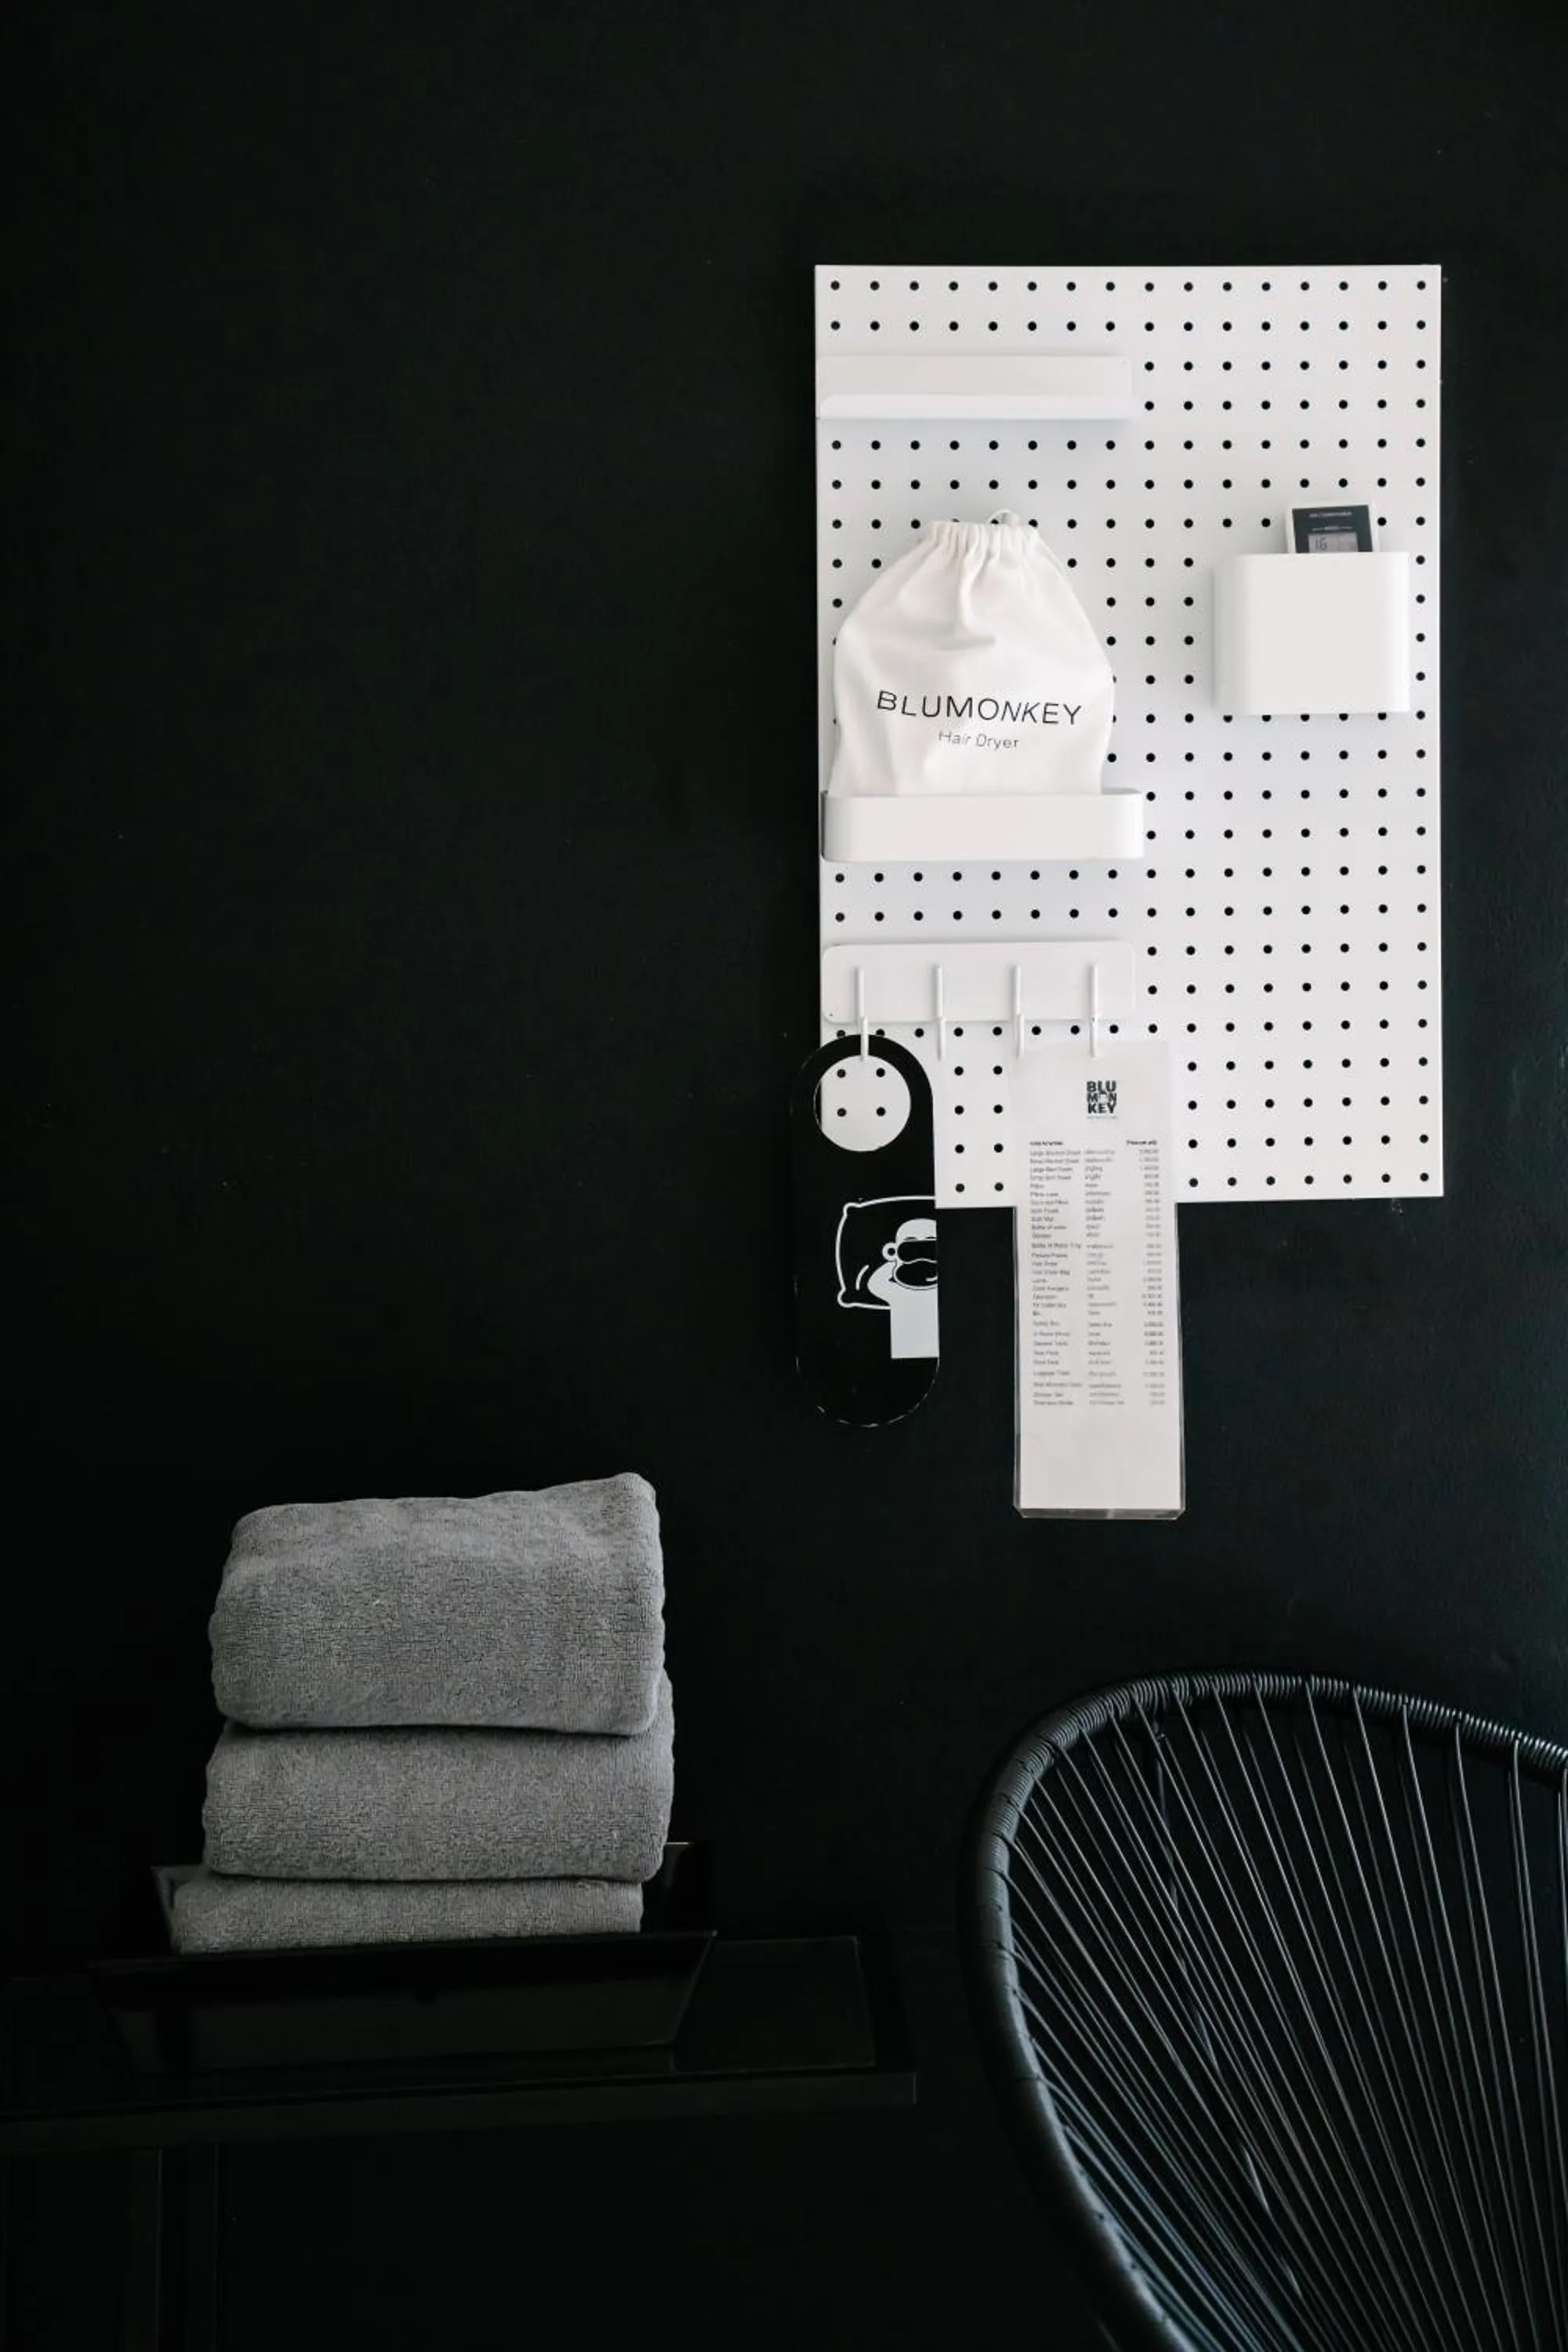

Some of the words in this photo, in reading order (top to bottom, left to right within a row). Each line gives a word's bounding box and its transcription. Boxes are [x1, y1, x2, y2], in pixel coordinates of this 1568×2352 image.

[877, 690, 1082, 725] BLUMONKEY
[938, 730, 971, 744] Hair
[976, 732, 1019, 750] Dryer
[1087, 1080, 1116, 1092] BLU
[1087, 1102, 1116, 1114] KEY
